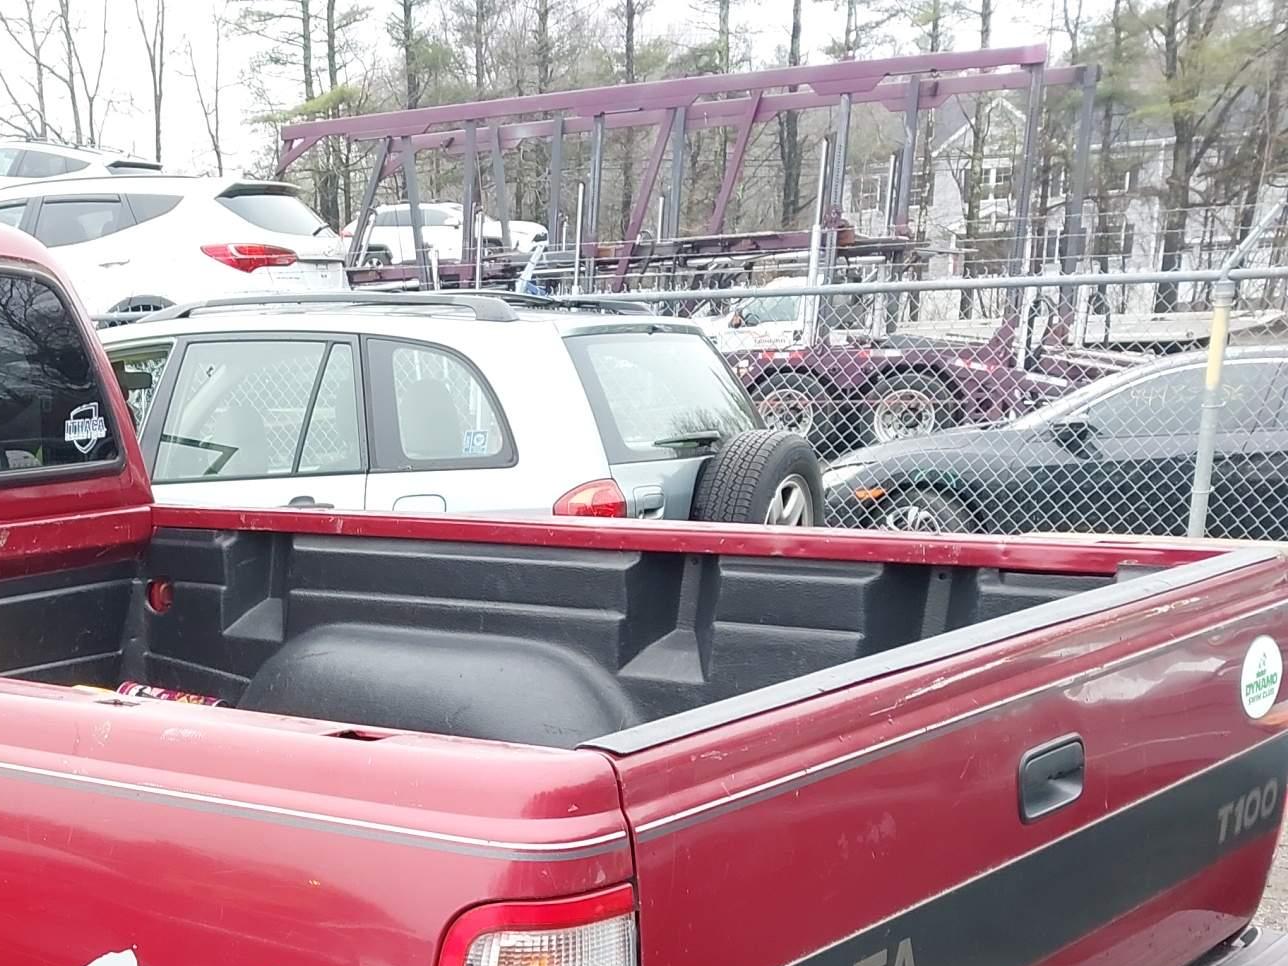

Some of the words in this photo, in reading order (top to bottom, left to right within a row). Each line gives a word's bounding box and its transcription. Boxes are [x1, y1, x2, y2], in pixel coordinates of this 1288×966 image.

[65, 417, 107, 435] ITHACA
[1245, 671, 1278, 697] DYNAMO
[1217, 777, 1278, 845] T100
